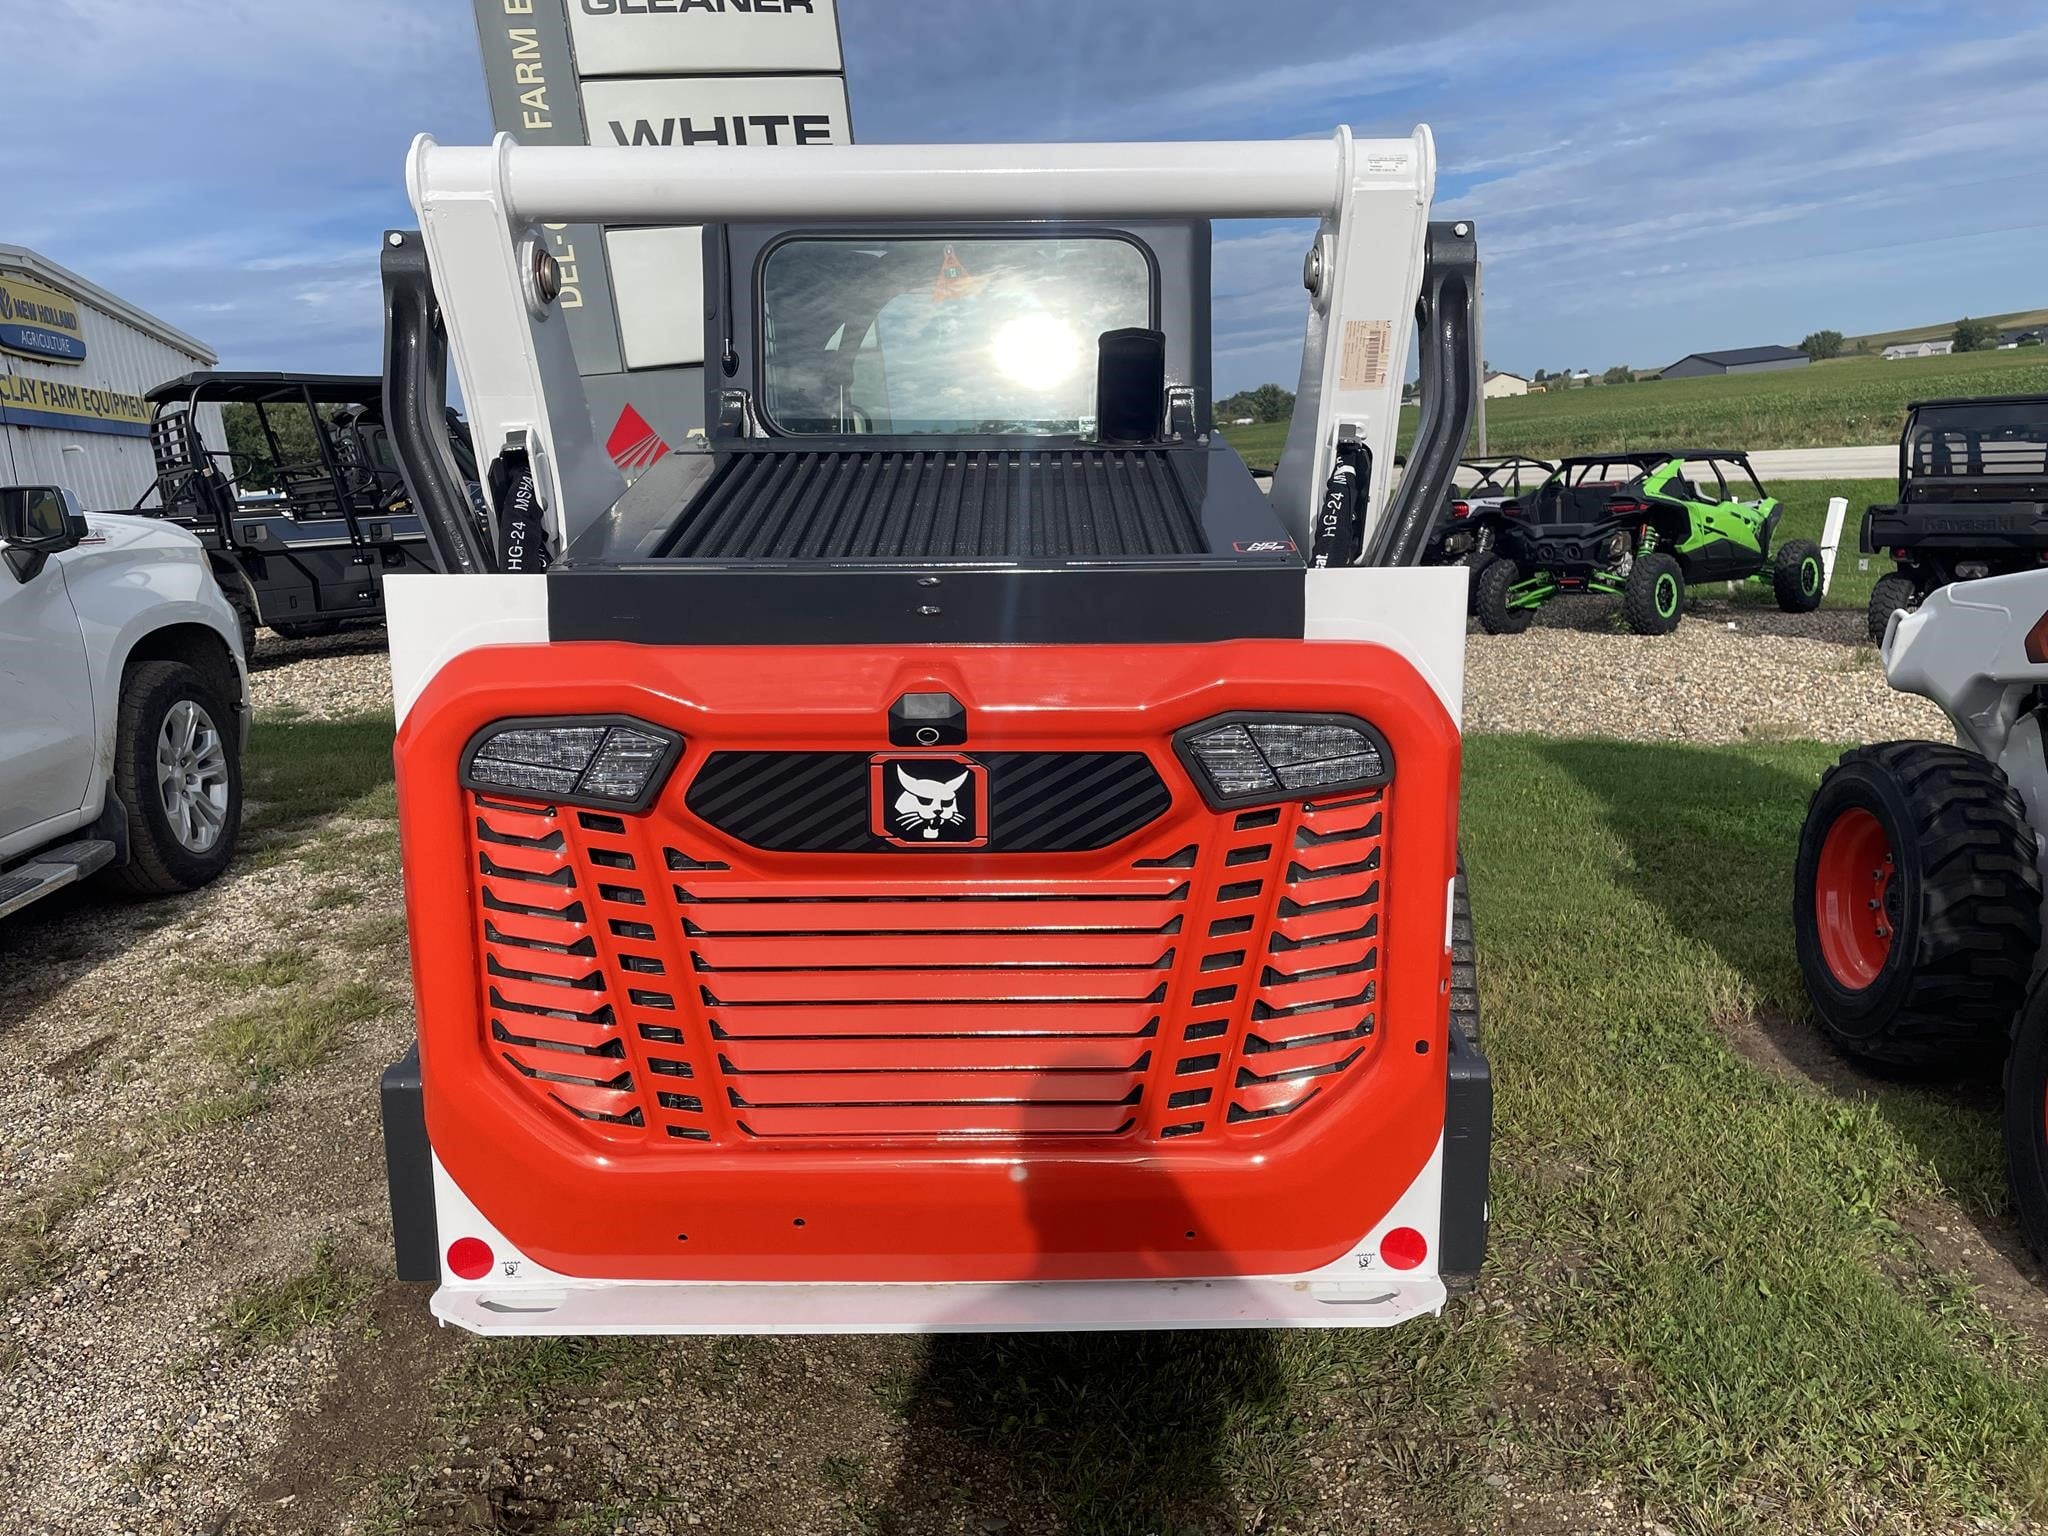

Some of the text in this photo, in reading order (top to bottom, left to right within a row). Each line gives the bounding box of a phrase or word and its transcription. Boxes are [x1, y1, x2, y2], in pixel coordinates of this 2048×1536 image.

[508, 28, 553, 129] FARM
[608, 115, 834, 146] WHITE
[543, 223, 583, 309] DEL-
[13, 298, 77, 330] NEW HOLLAND
[21, 330, 71, 353] AGRICULTURE
[40, 380, 81, 410] FARM
[1322, 492, 1344, 537] HG-24
[508, 521, 526, 571] HG-24
